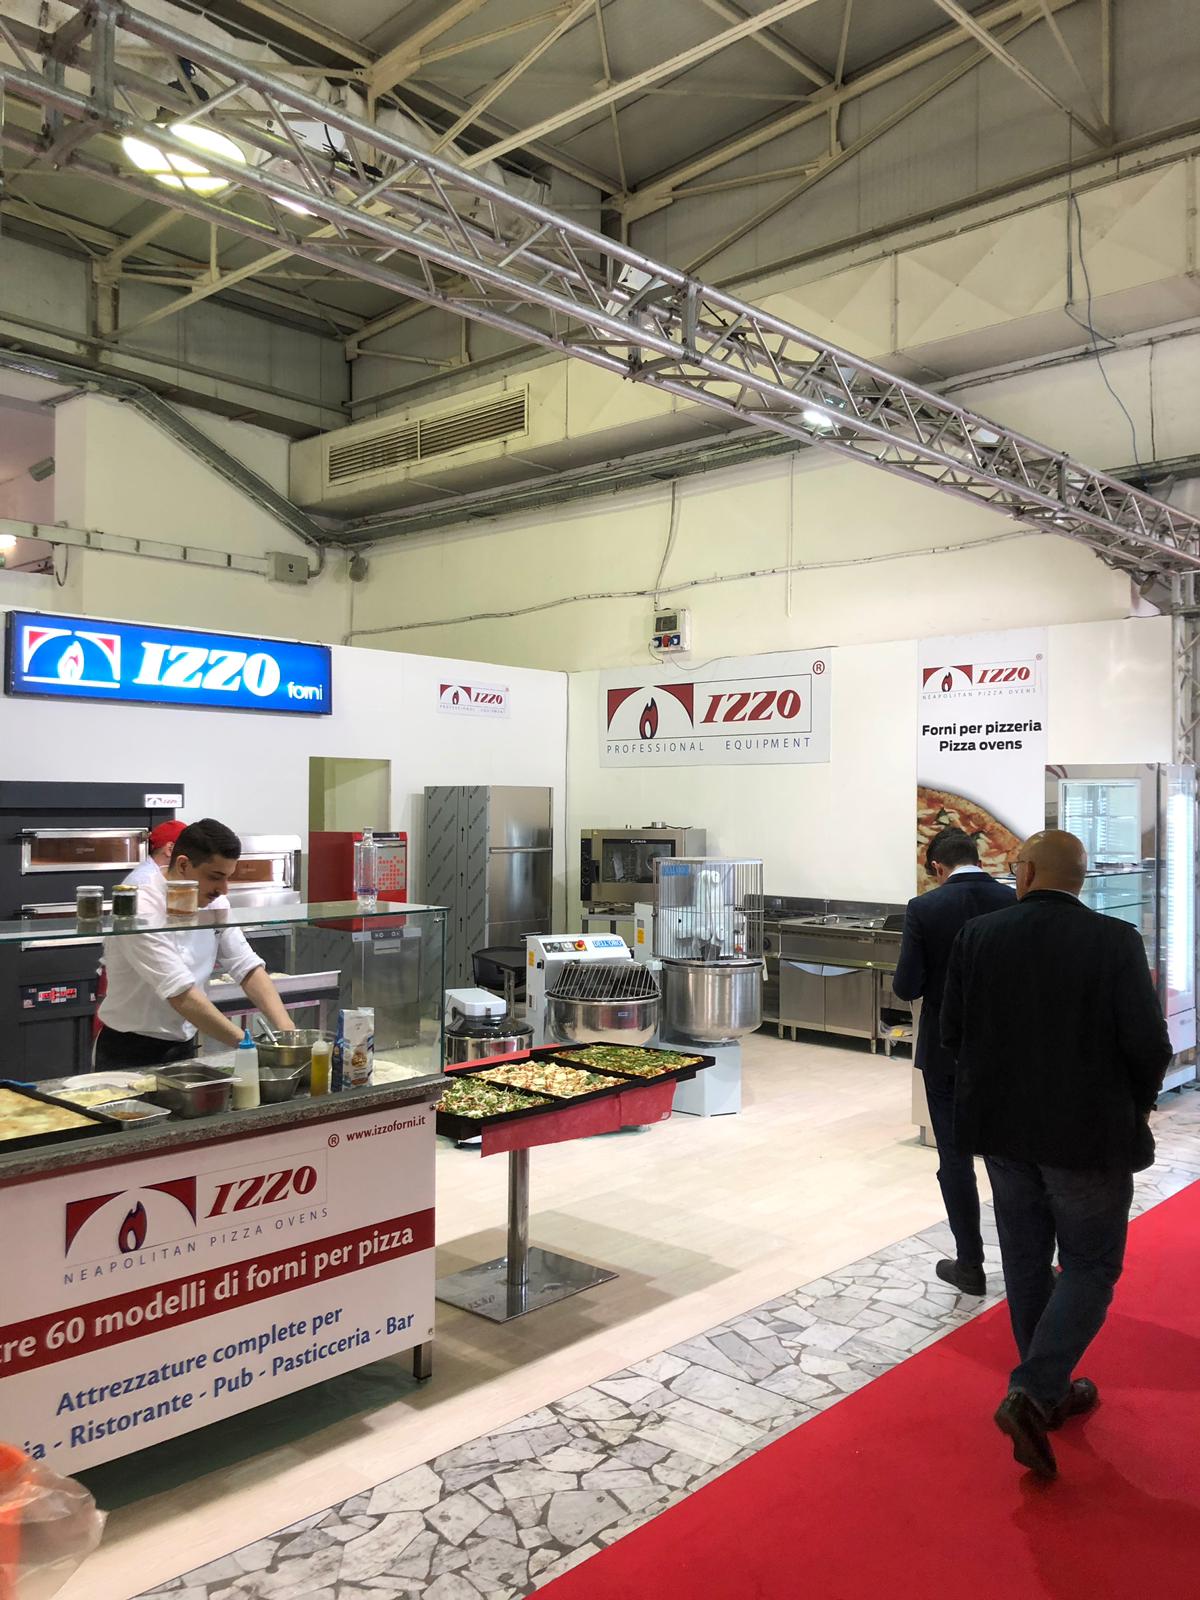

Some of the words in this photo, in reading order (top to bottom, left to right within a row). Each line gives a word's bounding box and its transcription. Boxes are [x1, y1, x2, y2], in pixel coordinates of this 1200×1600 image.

[132, 641, 281, 697] IZZO
[976, 666, 1031, 684] IZZO
[474, 692, 503, 705] IZZO
[699, 689, 801, 724] IZZO
[607, 740, 705, 754] PROFESSIONAL
[725, 737, 811, 751] EQUIPMENT
[922, 723, 956, 737] Forni
[959, 724, 982, 737] per
[985, 719, 1042, 736] pizzeria
[939, 740, 976, 752] Pizza
[979, 739, 1023, 751] ovens
[346, 1115, 426, 1142] www.izzoforni.it
[203, 1165, 318, 1219] IZZO
[64, 1242, 196, 1285] NEAPOLITAN
[210, 1225, 263, 1247] PIZZA
[275, 1207, 328, 1230] OVENS
[46, 1316, 86, 1350] 60
[95, 1279, 206, 1337] modelli
[213, 1270, 239, 1301] di
[246, 1251, 307, 1292] forni
[314, 1243, 353, 1279] per
[358, 1227, 414, 1265] pizza
[56, 1353, 207, 1417] Attrezzature
[213, 1319, 307, 1364] complete
[312, 1307, 343, 1336] per
[70, 1392, 193, 1448] Ristorante
[213, 1367, 253, 1398] Pub
[272, 1328, 371, 1377] Pasticceria
[386, 1313, 415, 1336] Bar
